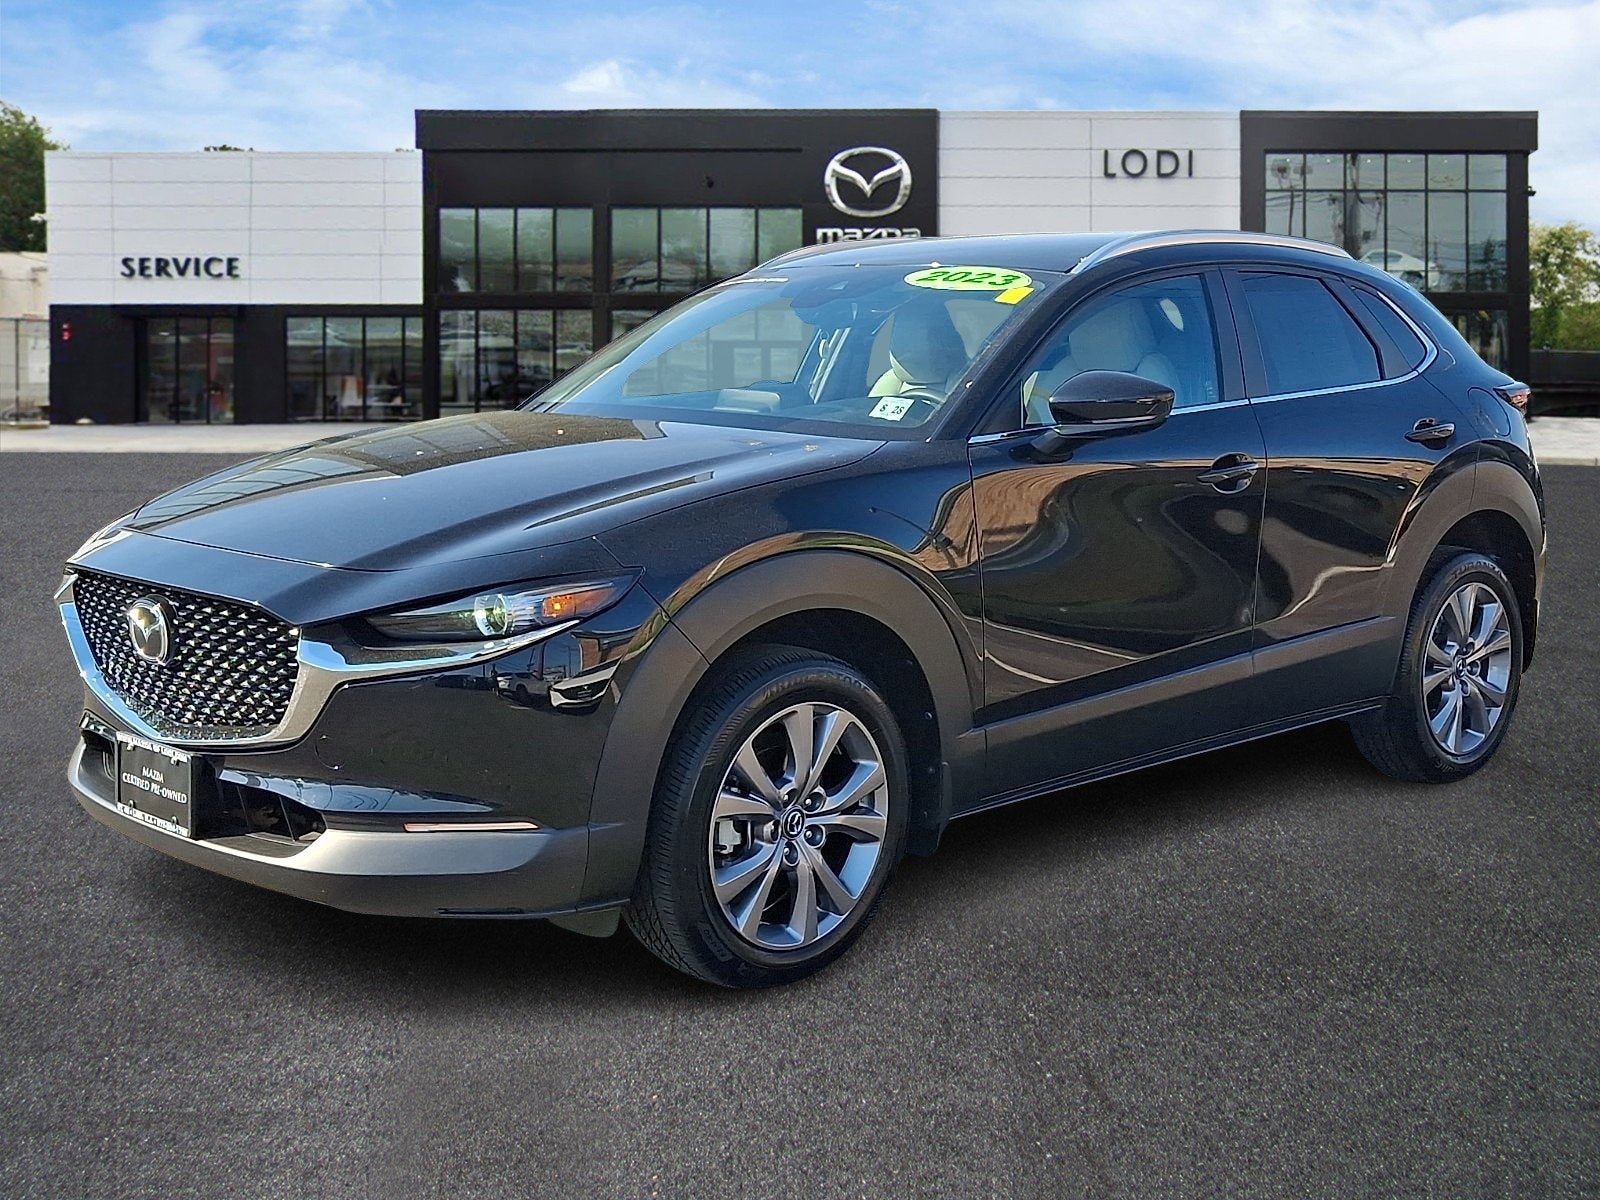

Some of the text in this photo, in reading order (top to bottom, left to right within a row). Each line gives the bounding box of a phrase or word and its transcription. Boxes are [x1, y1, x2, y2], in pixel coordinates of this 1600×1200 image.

[1103, 149, 1193, 178] LODI
[120, 256, 240, 278] SERVICE
[915, 271, 1021, 286] 2023
[142, 767, 164, 783] MAZDA
[122, 773, 187, 803] CERTIFIED PRE-OWNED
